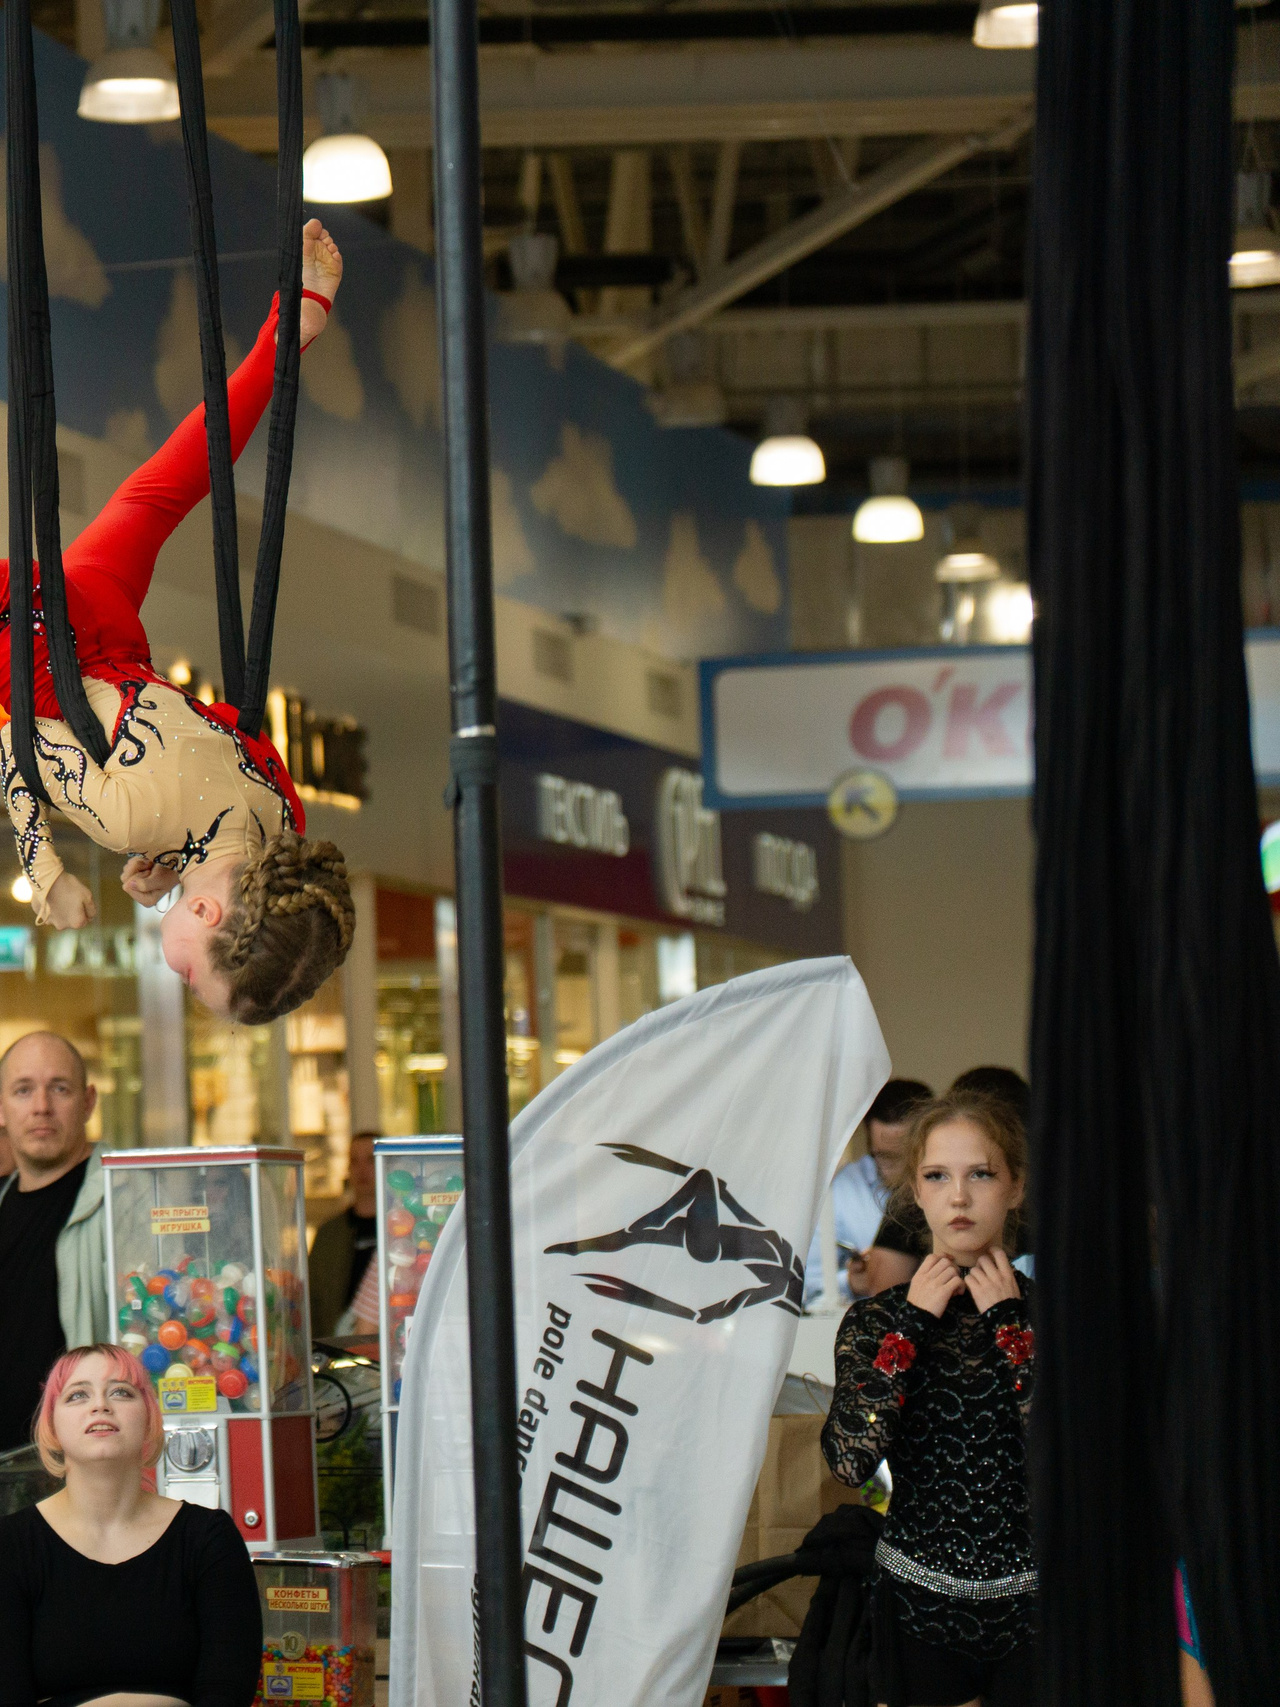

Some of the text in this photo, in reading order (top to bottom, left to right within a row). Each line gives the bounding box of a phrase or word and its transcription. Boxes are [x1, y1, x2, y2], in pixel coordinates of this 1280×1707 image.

[849, 664, 1034, 763] О'К
[173, 1208, 207, 1217] ПРЫГУН
[160, 1222, 202, 1232] ИГРУШКА
[517, 1302, 572, 1491] pole dan
[274, 1589, 320, 1599] КОНФЕТЫ
[270, 1600, 308, 1610] НЕСКОЛЬКО
